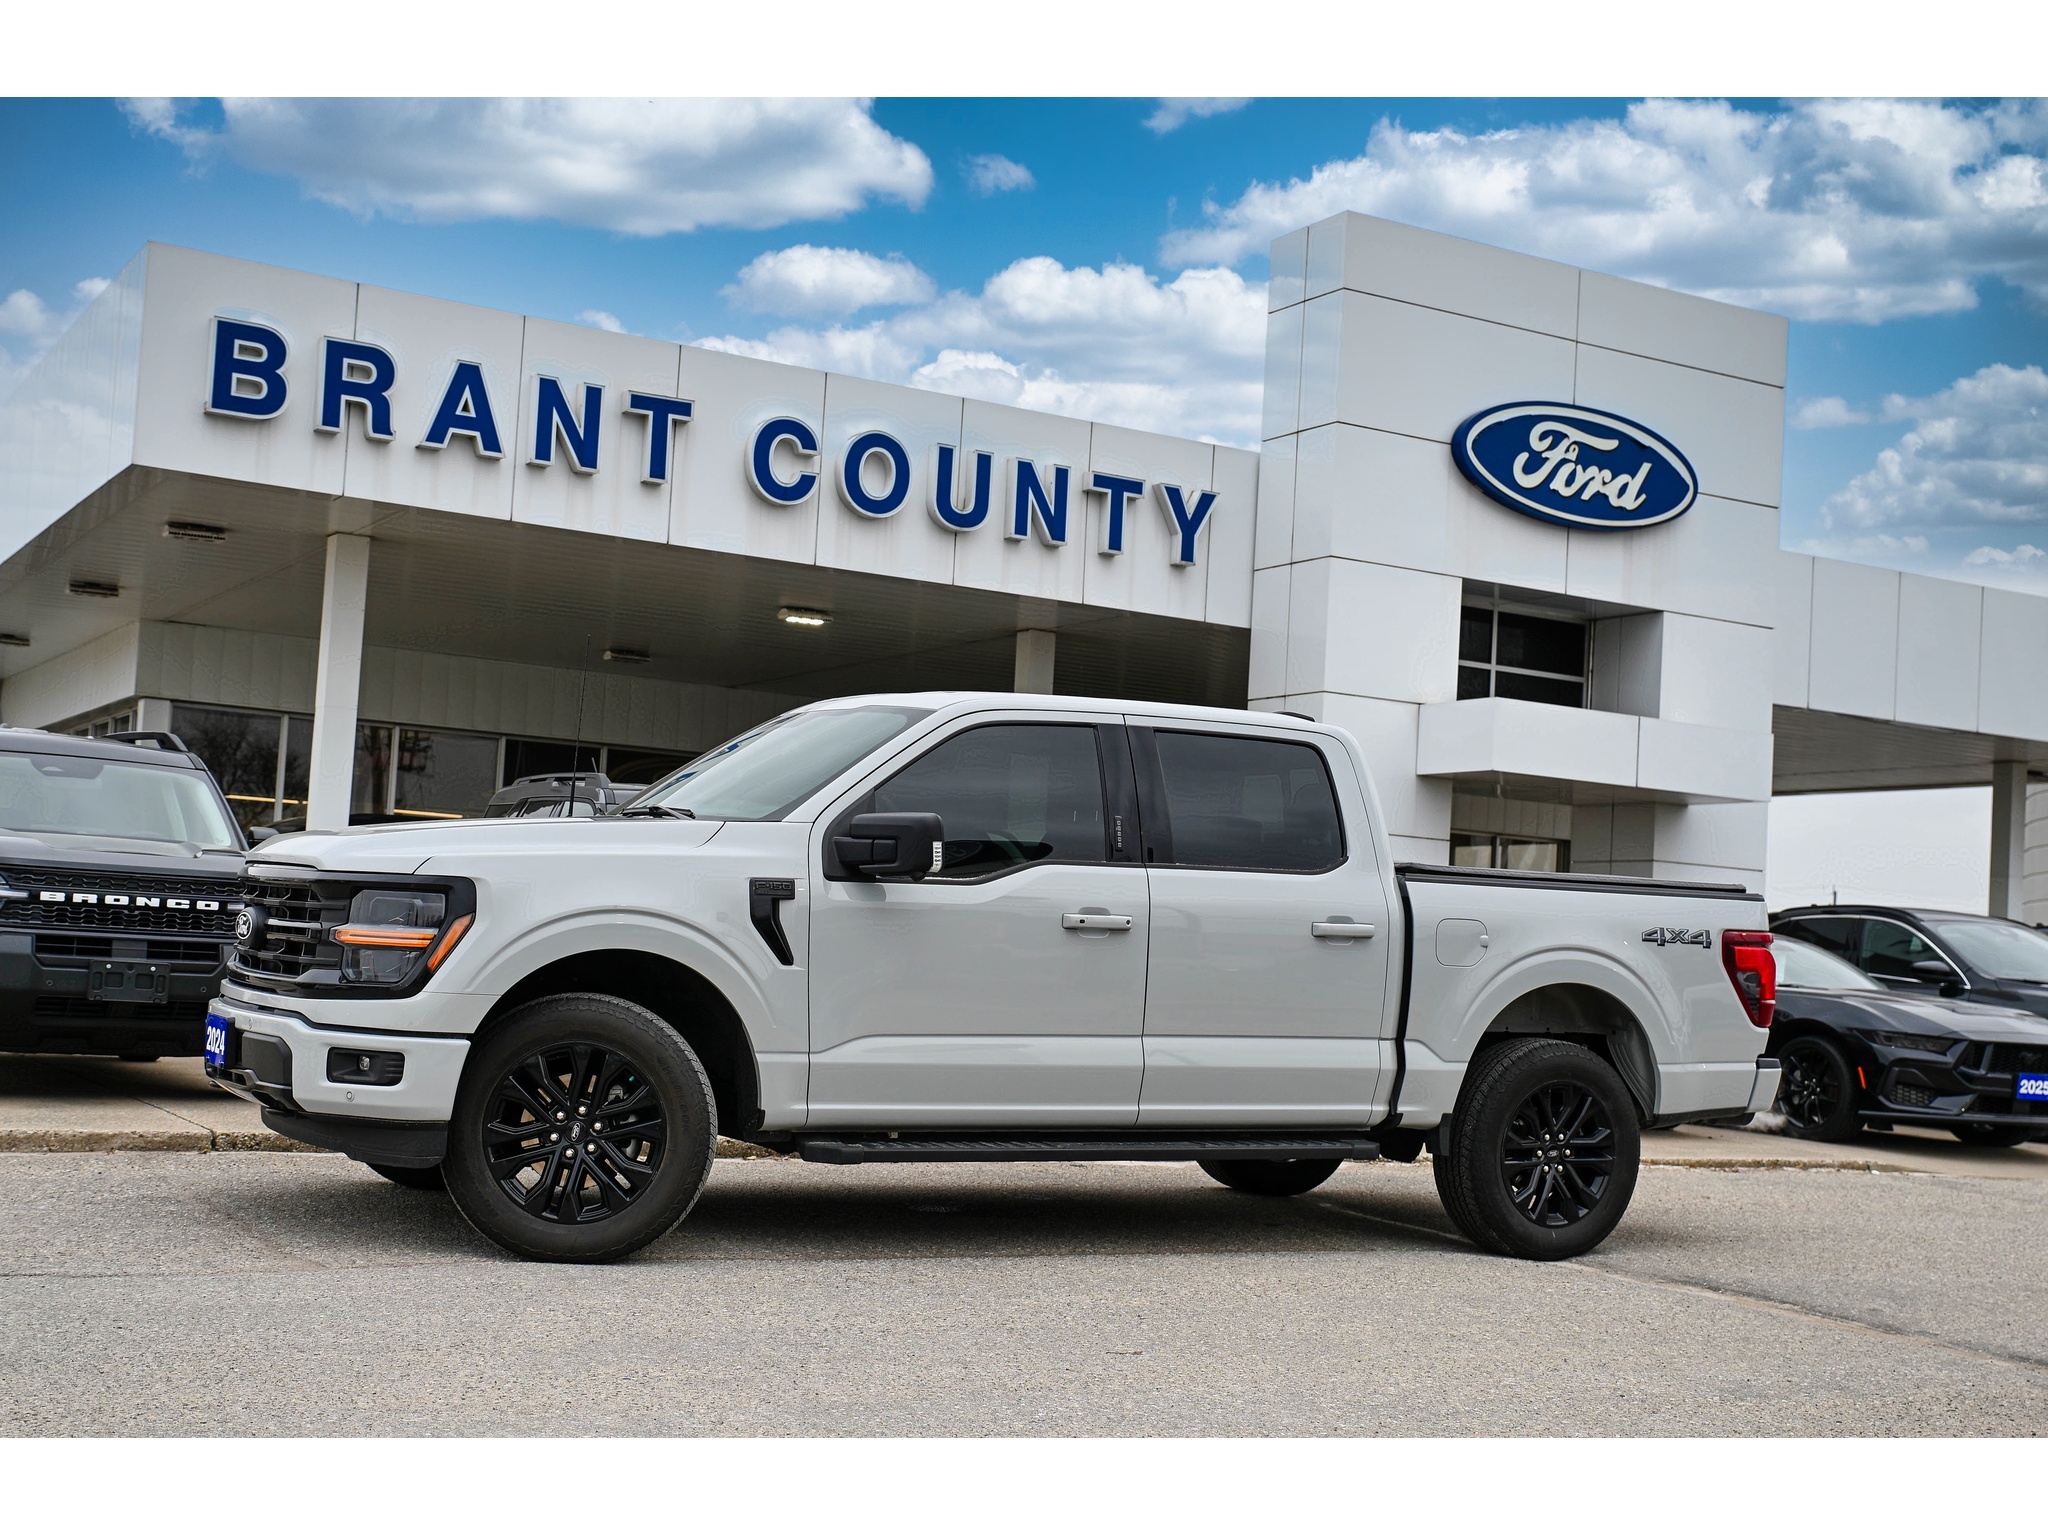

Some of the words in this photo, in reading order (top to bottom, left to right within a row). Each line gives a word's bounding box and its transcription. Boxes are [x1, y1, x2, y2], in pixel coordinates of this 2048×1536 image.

[204, 315, 696, 485] BRANT
[745, 415, 1221, 568] COUNTY
[1513, 421, 1652, 511] Ford
[39, 890, 220, 912] BRONCO
[206, 1025, 226, 1056] 2024
[2019, 1078, 2048, 1096] 2025
